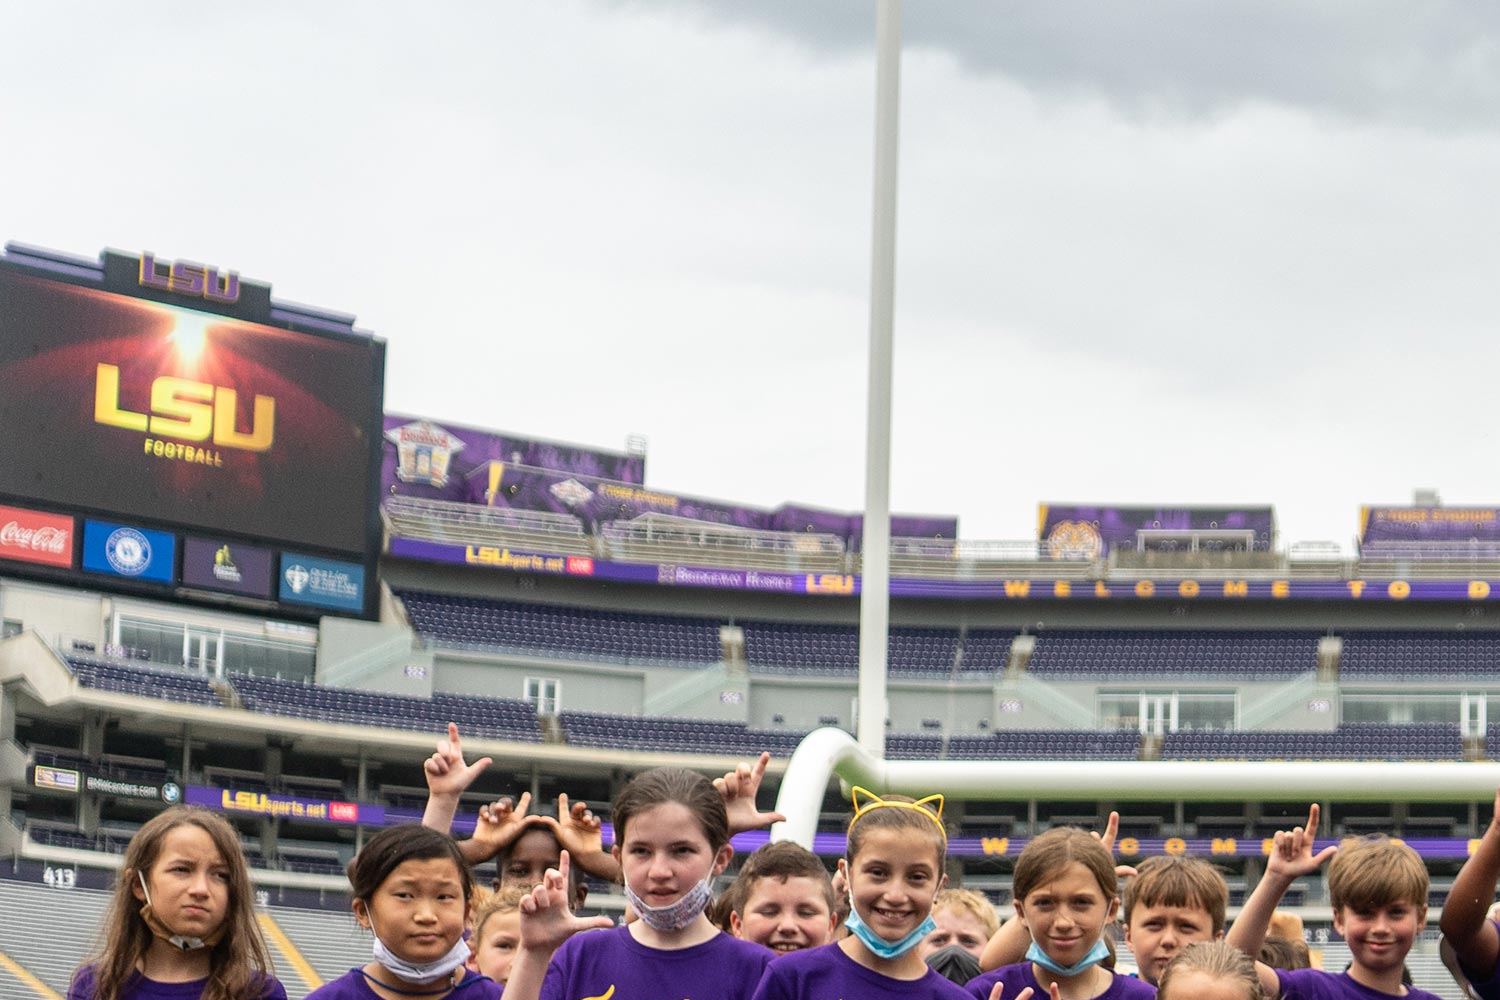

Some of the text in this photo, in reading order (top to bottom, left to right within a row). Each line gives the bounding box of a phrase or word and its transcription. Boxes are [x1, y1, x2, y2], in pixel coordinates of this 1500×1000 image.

[139, 251, 241, 302] LSU
[94, 362, 275, 452] LSU
[143, 438, 222, 467] FOOTBALL
[806, 573, 853, 594] LSU
[1004, 580, 1291, 599] WELCOME
[1347, 580, 1411, 599] TO
[221, 788, 326, 820] LSUsports.net
[43, 867, 75, 888] 413
